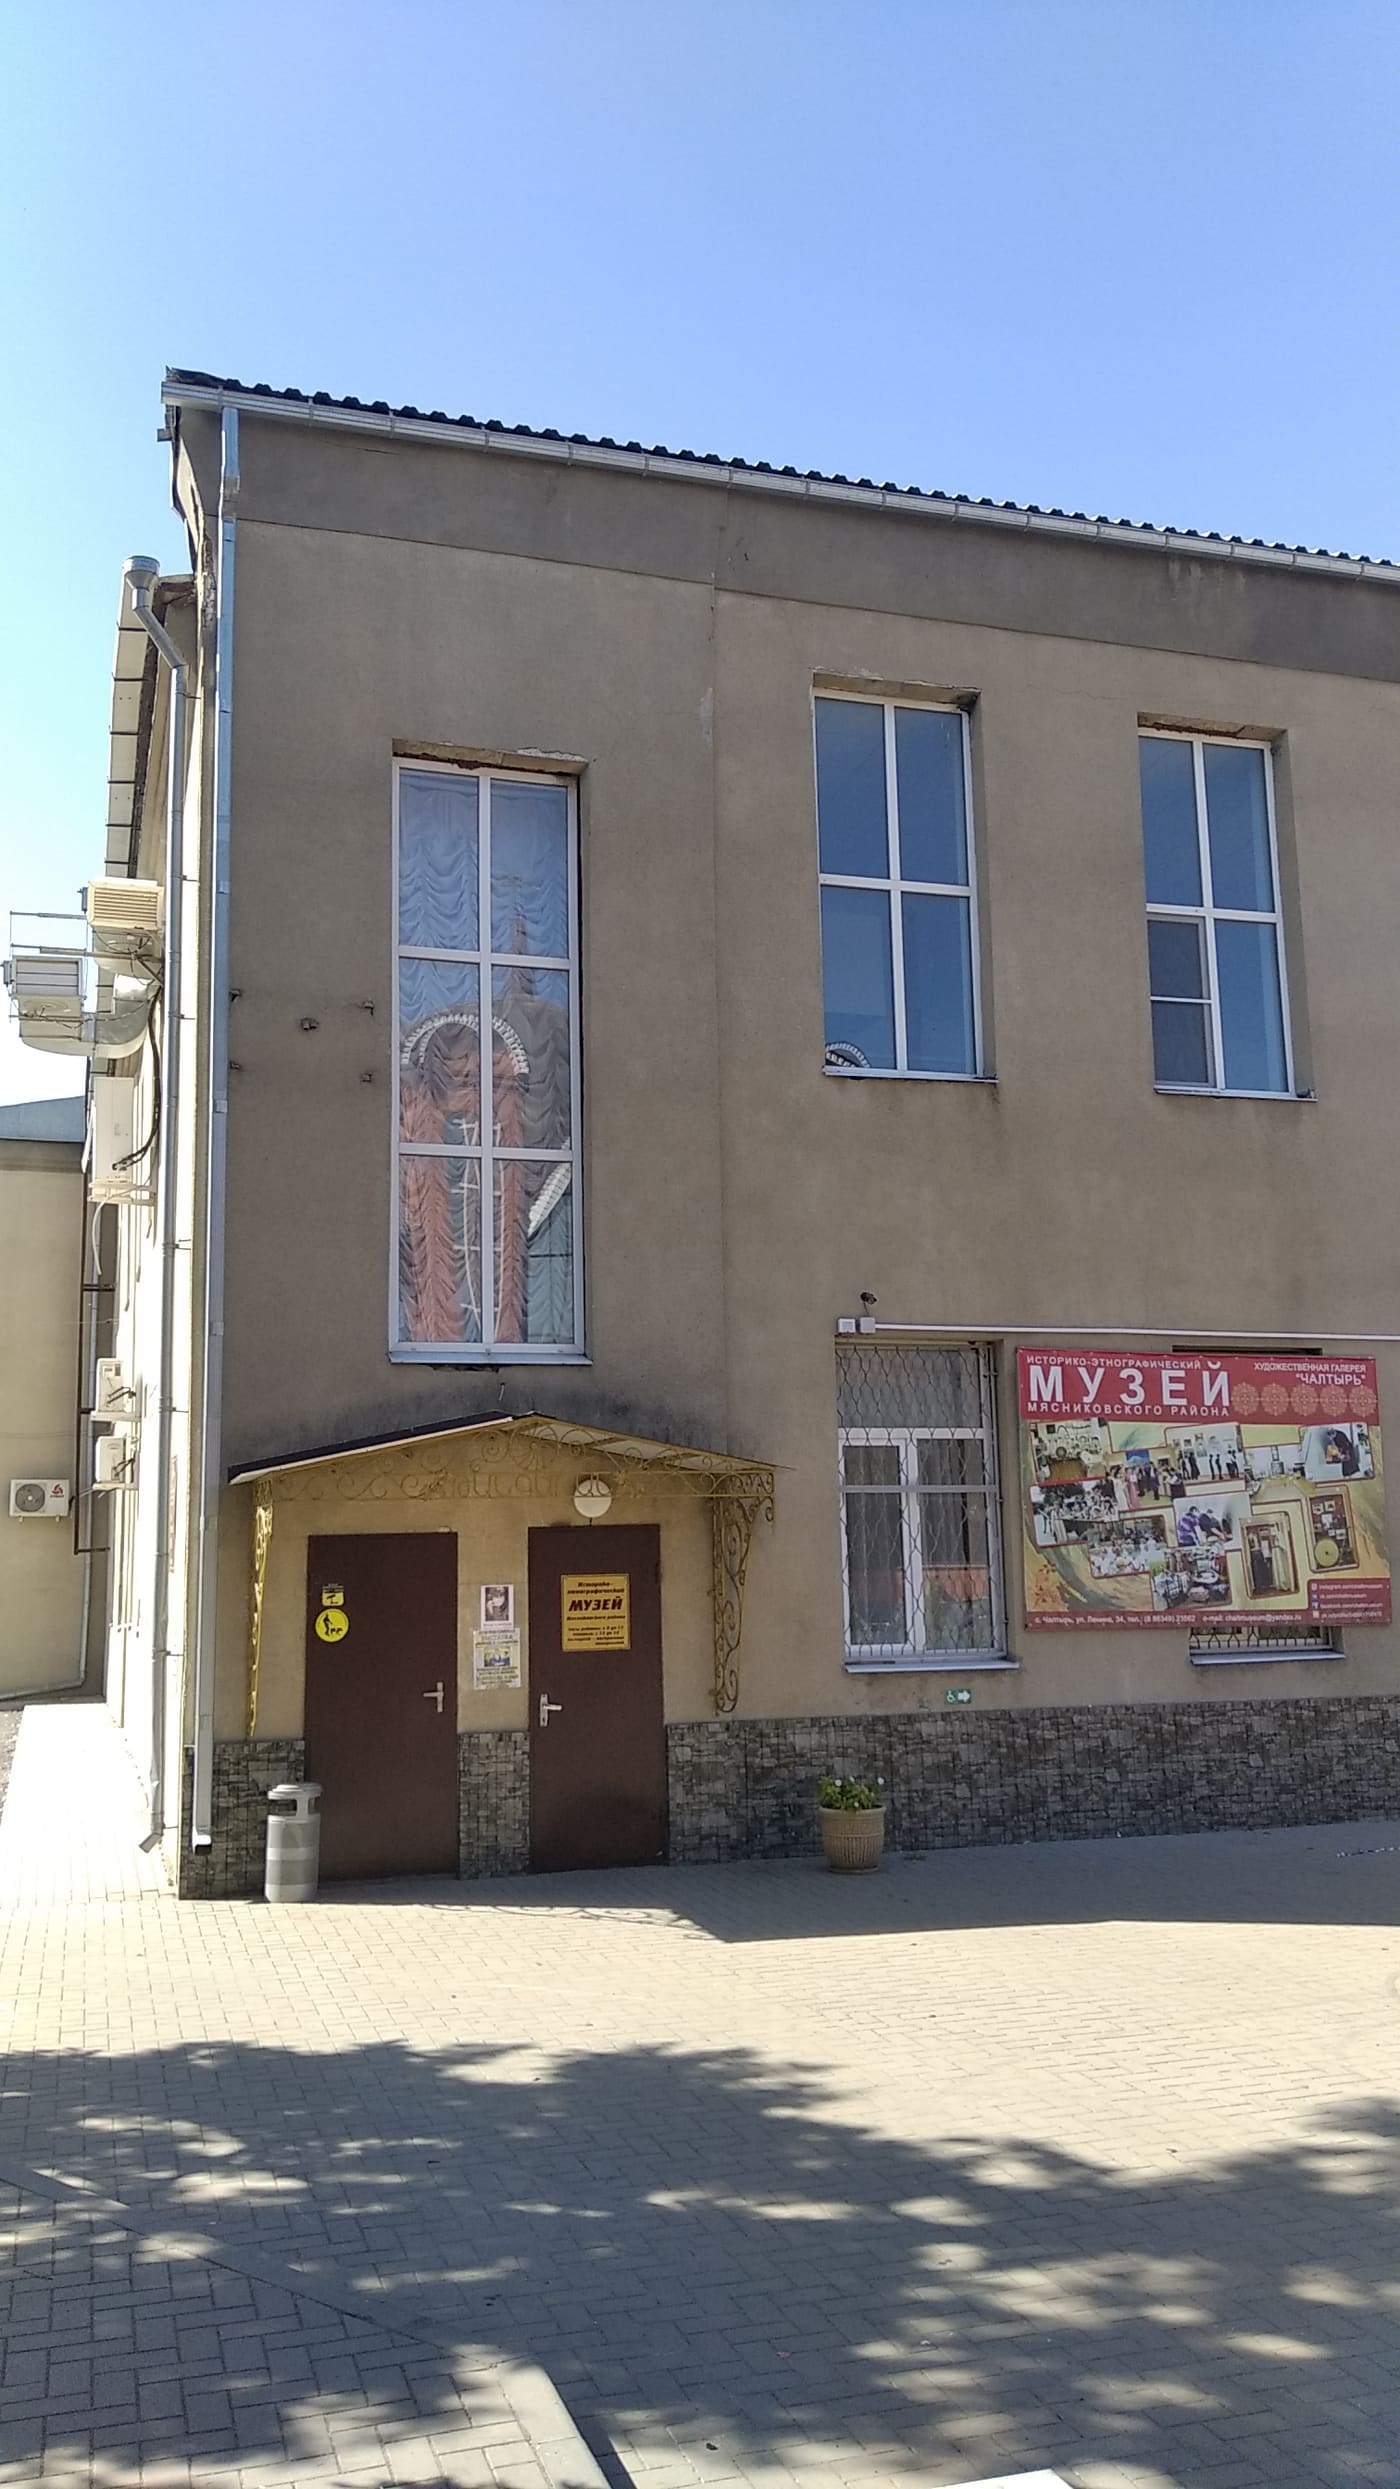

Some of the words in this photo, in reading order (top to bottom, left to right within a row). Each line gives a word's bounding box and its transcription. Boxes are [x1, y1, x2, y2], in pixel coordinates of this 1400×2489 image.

[1026, 1355, 1201, 1369] ИСТОРИКО-ЭТНОГРАФИЧЕСКИЙ
[1254, 1362, 1329, 1373] ХУДОЖЕСТВЕННАЯ
[1330, 1364, 1366, 1373] ГАЛЕРЕЯ
[1029, 1360, 1230, 1407] МУЗЕЙ
[1295, 1373, 1366, 1385] "ЧАЛТЫРЬ"
[1027, 1402, 1162, 1415] МЯСНИКОВСКОГО
[1171, 1405, 1230, 1417] РАЙОНА
[568, 1596, 623, 1612] МУЗЕЙ
